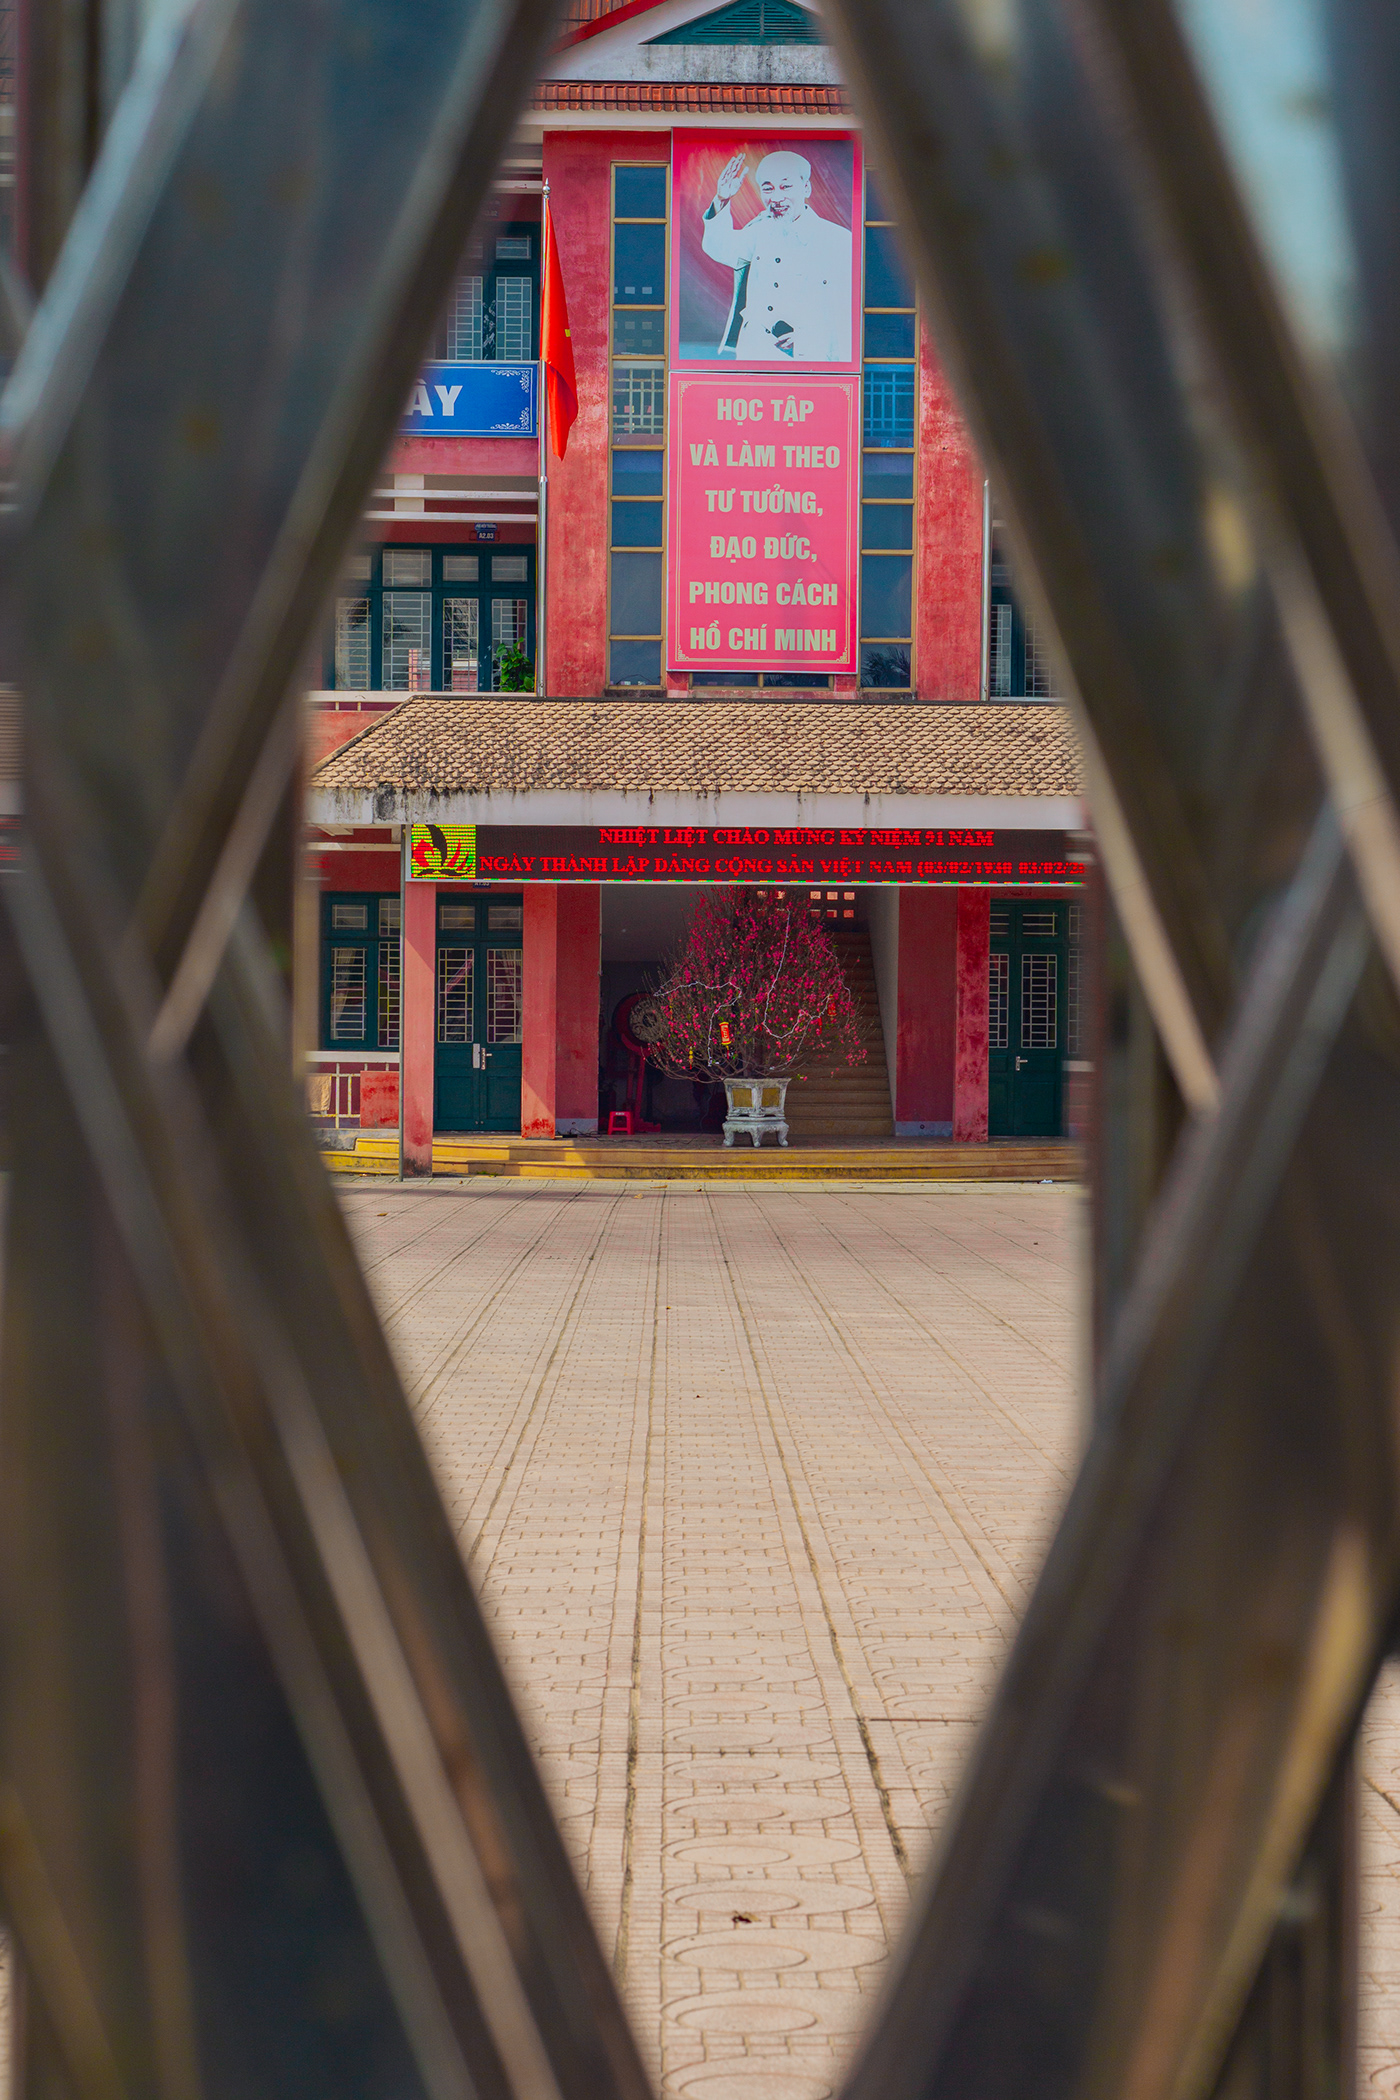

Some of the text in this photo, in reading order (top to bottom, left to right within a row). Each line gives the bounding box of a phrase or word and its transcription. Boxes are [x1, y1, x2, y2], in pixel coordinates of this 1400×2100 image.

[717, 395, 814, 427] HỌC TẬP
[690, 439, 840, 469] VÀ LÀM THEO
[705, 483, 823, 517] TƯ TƯỞNG,
[710, 531, 817, 564] ĐẠO ĐỨC,
[690, 577, 838, 606] PHONG CÁCH
[690, 620, 837, 652] HỒ CHÍ MINH
[599, 826, 659, 847] NHIỆT
[663, 827, 708, 847] LIỆT
[925, 831, 944, 846] 91
[479, 853, 536, 871] NGÀY
[540, 853, 608, 872] THÀNH
[612, 856, 649, 876] LẬP
[715, 856, 773, 877] CỘNG
[819, 857, 864, 877] VIỆT
[870, 861, 912, 873] NAM
